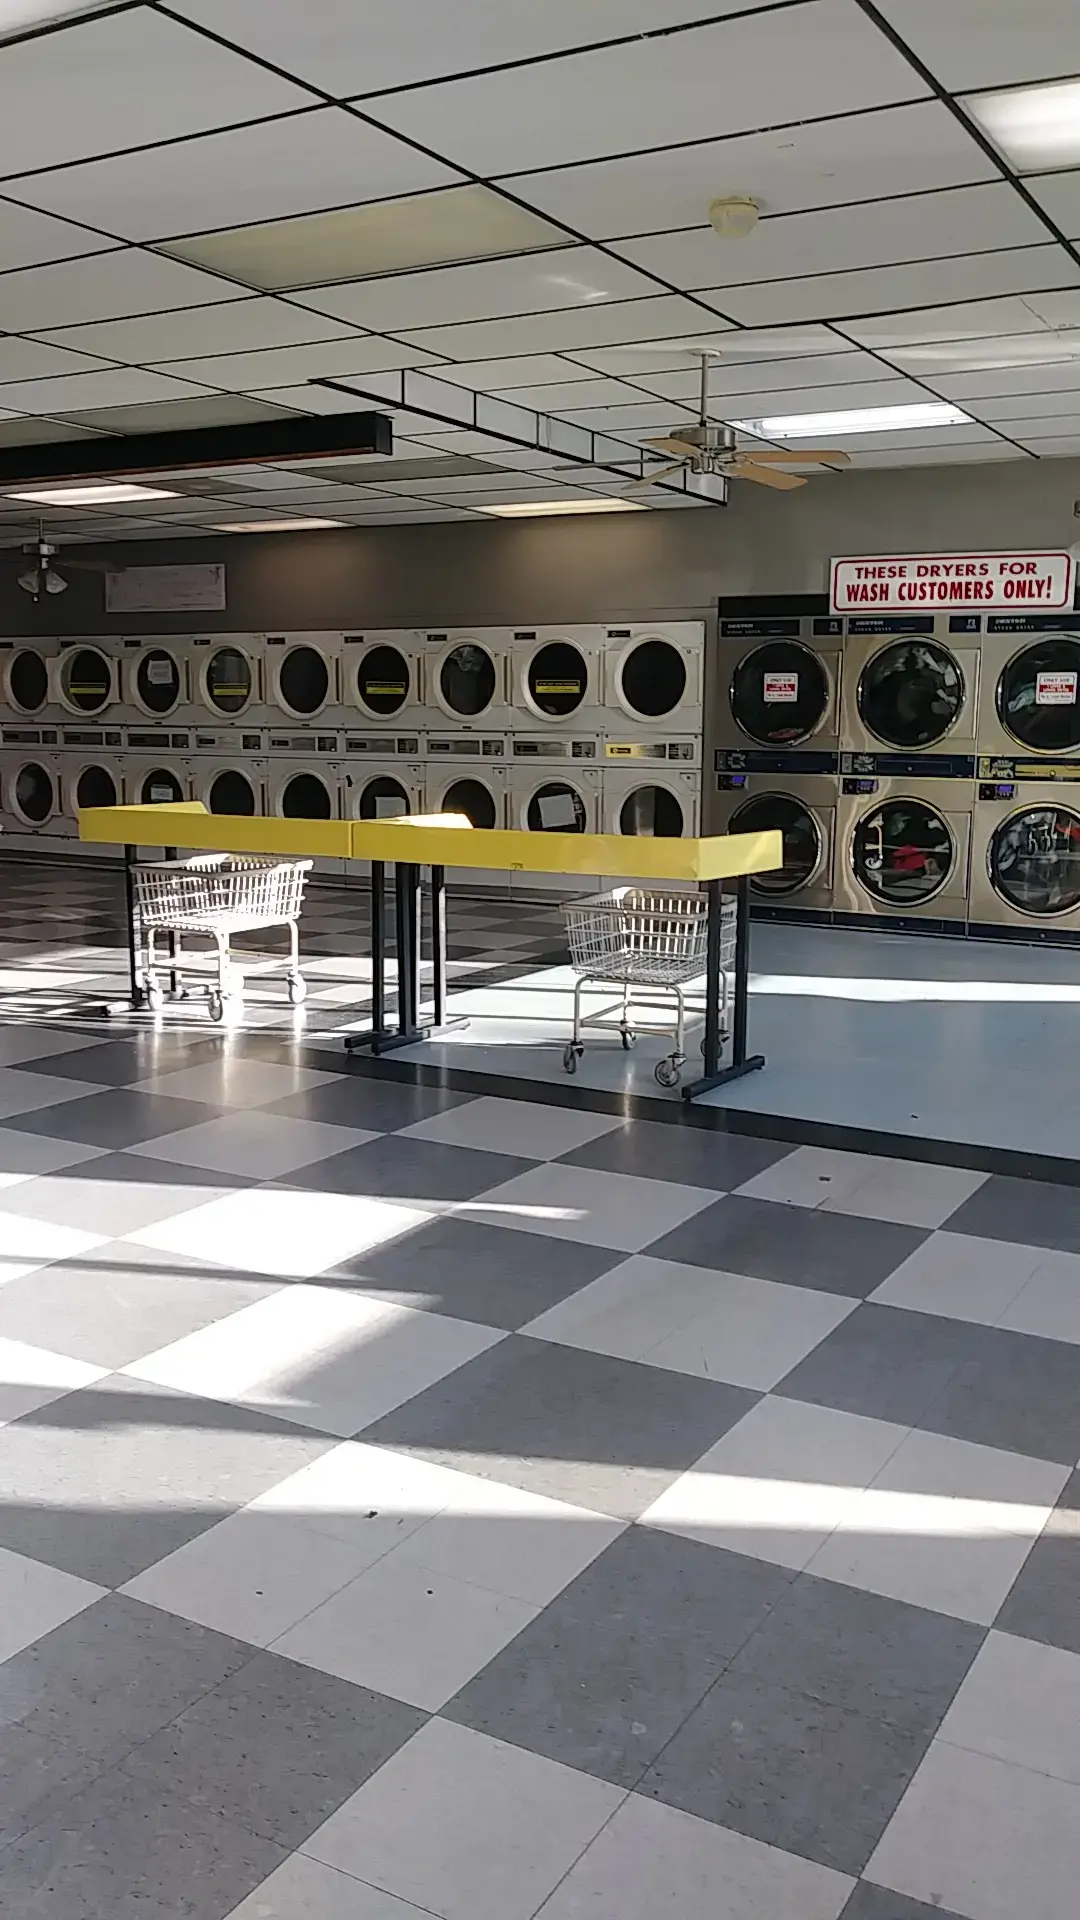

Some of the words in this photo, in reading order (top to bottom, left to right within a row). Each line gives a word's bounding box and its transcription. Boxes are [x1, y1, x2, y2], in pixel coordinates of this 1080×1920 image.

[855, 566, 907, 579] THESE
[917, 563, 989, 577] DRYERS
[999, 562, 1037, 575] FOR
[846, 583, 889, 602] WASH
[898, 580, 994, 601] CUSTOMERS
[1004, 575, 1052, 599] ONLY!
